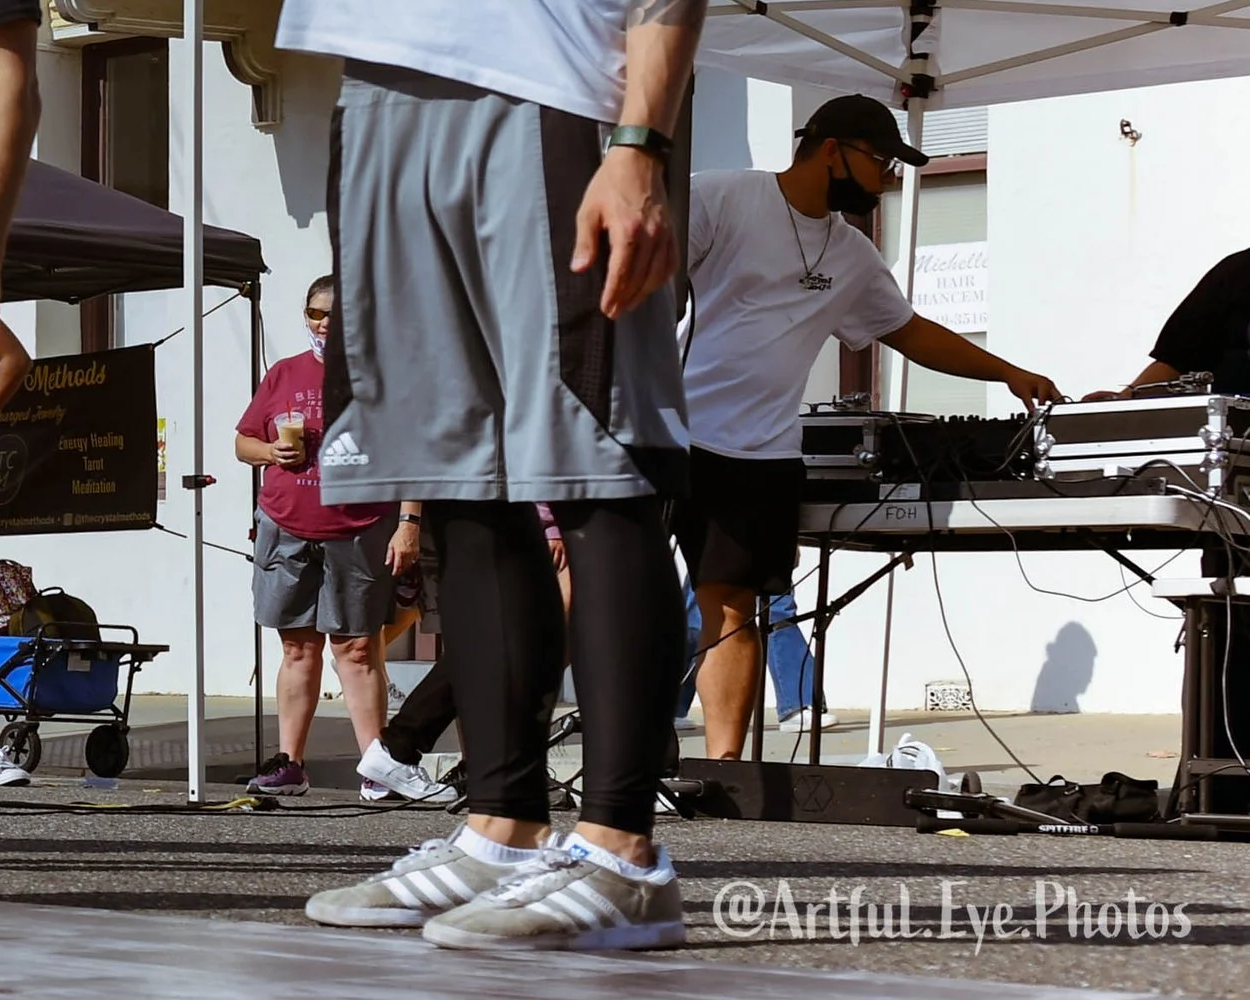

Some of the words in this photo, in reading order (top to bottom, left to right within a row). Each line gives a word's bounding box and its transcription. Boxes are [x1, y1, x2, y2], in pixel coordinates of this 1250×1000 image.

[937, 275, 975, 289] HAIR
[24, 361, 106, 395] Methods
[58, 436, 88, 452] Energy
[90, 432, 124, 450] Healing
[82, 456, 104, 471] Tarot
[72, 478, 116, 495] Meditation
[885, 505, 917, 520] FOH
[1038, 824, 1088, 834] SPITFIRE
